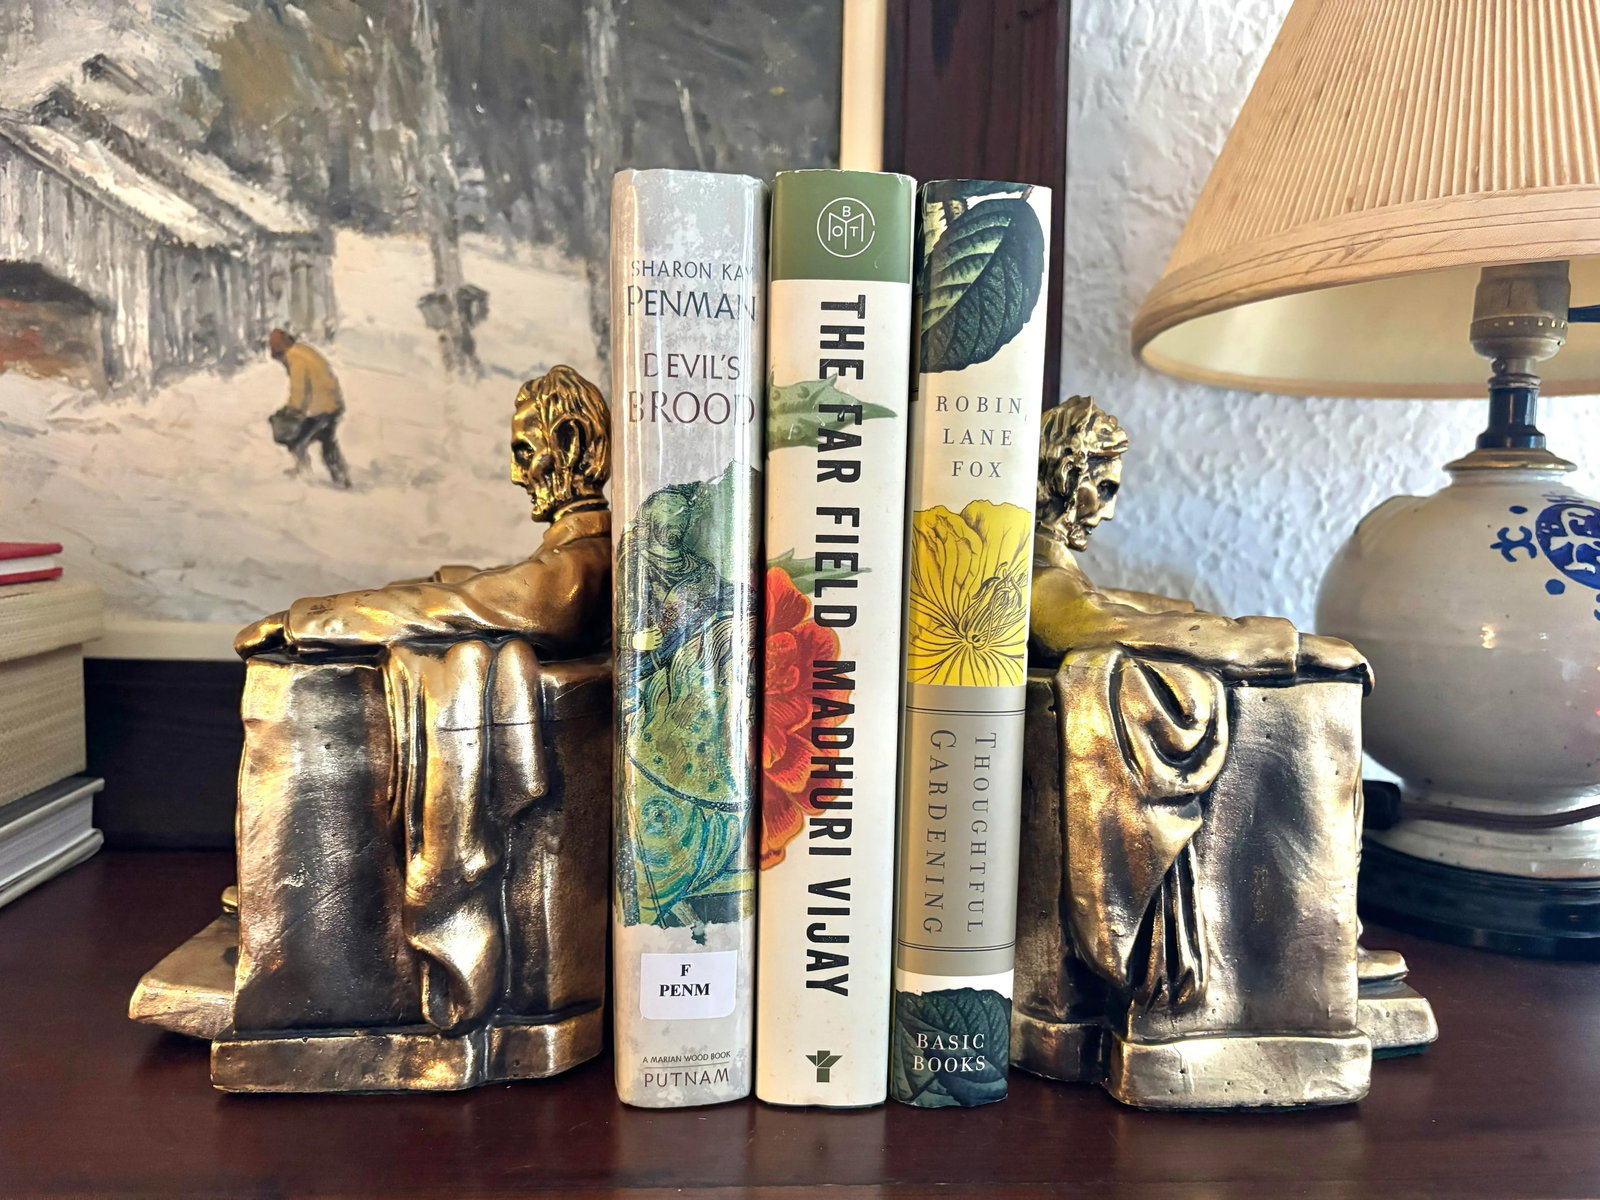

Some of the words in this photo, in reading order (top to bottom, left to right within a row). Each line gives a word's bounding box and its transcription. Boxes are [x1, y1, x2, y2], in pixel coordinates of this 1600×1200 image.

[631, 260, 712, 279] SHARON
[627, 285, 756, 321] PENMAN
[819, 294, 866, 380] THE
[644, 353, 741, 380] DEVIL'S
[628, 390, 755, 426] BROOD
[935, 395, 1022, 414] ROBIN
[816, 404, 863, 483] FAR
[942, 428, 1012, 446] LANE
[951, 460, 1002, 478] FOX
[814, 506, 860, 628] FIELD
[809, 660, 855, 856] MADHURI
[922, 729, 957, 934] GARDENING
[967, 732, 997, 933] THOUGHTFUL
[805, 877, 852, 997] VIJAY
[680, 964, 691, 976] F
[659, 983, 711, 997] PENM
[915, 1032, 986, 1050] BASIC
[642, 1056, 649, 1064] A
[650, 1055, 682, 1063] MARIAN
[684, 1053, 709, 1062] WOOD
[710, 1051, 731, 1059] BOOK
[911, 1054, 986, 1073] BOOKS
[644, 1068, 729, 1087] PUTNAM
